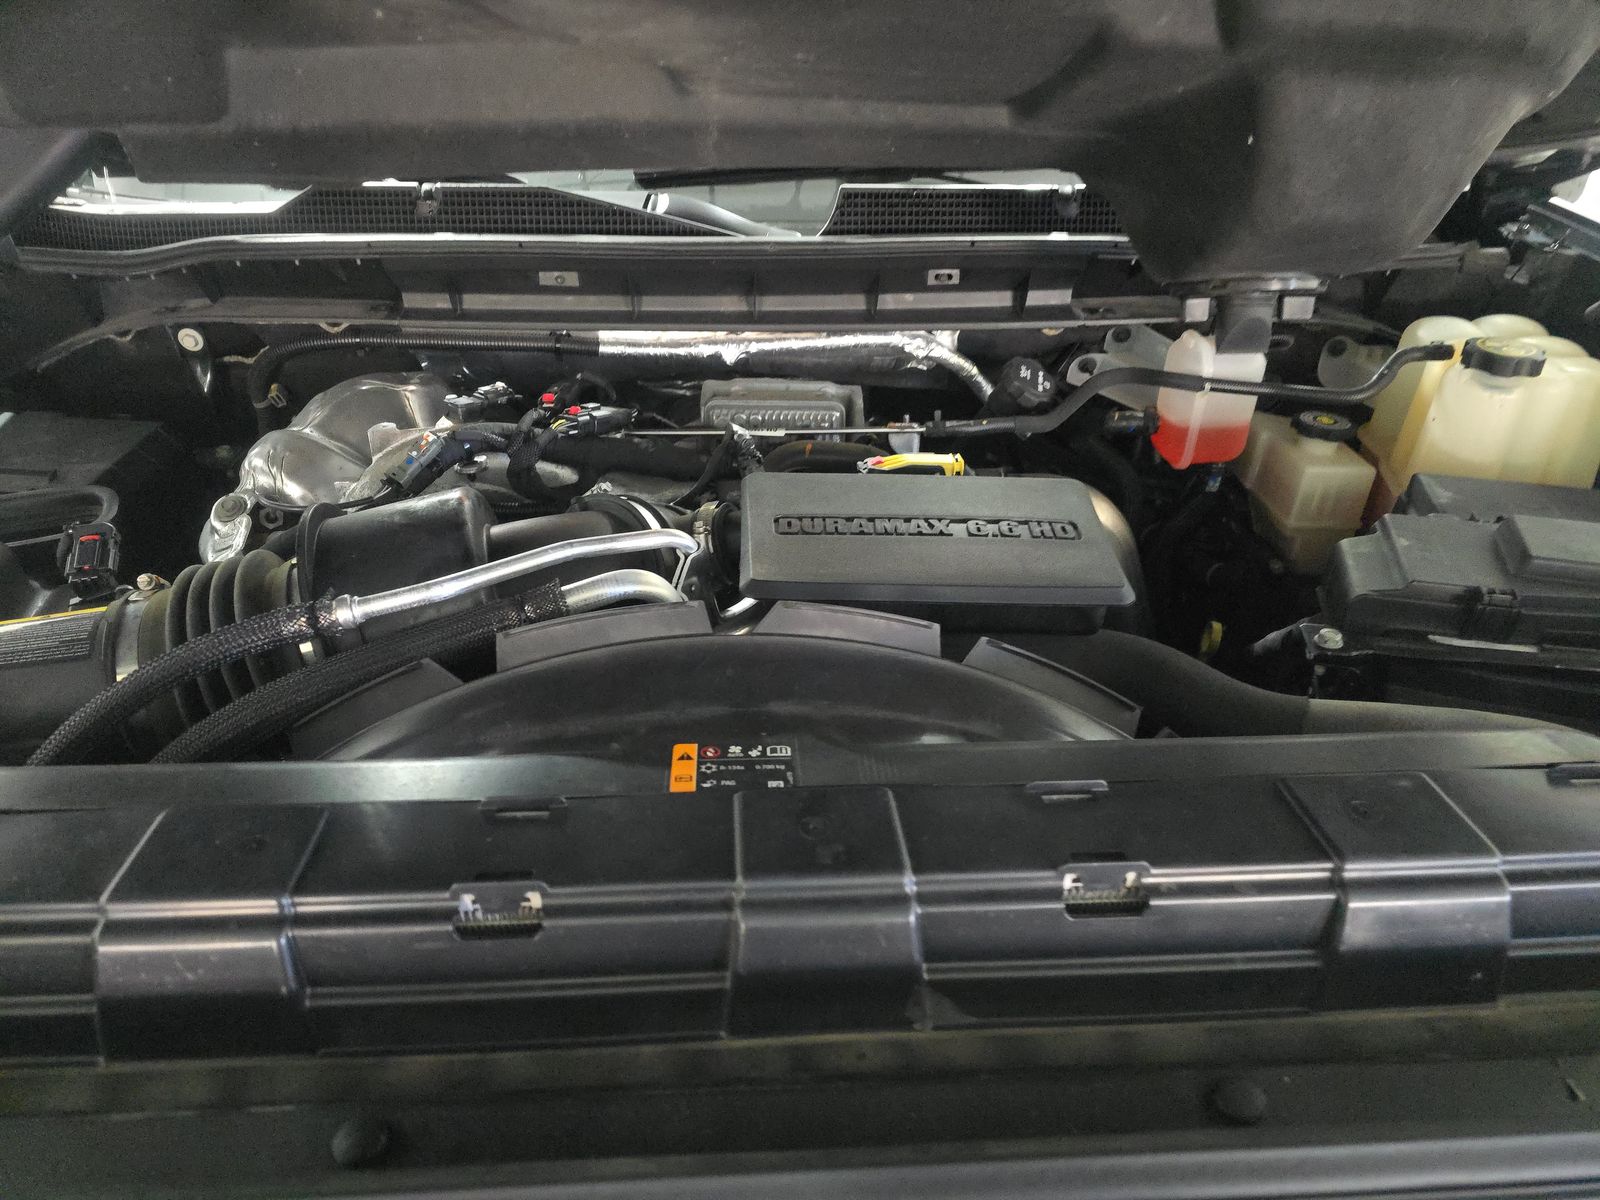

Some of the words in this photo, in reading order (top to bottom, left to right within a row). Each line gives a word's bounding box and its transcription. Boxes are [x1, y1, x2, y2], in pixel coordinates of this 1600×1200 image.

[777, 517, 952, 536] DURAMAX
[966, 519, 1022, 537] 6.6
[1027, 521, 1078, 540] HD
